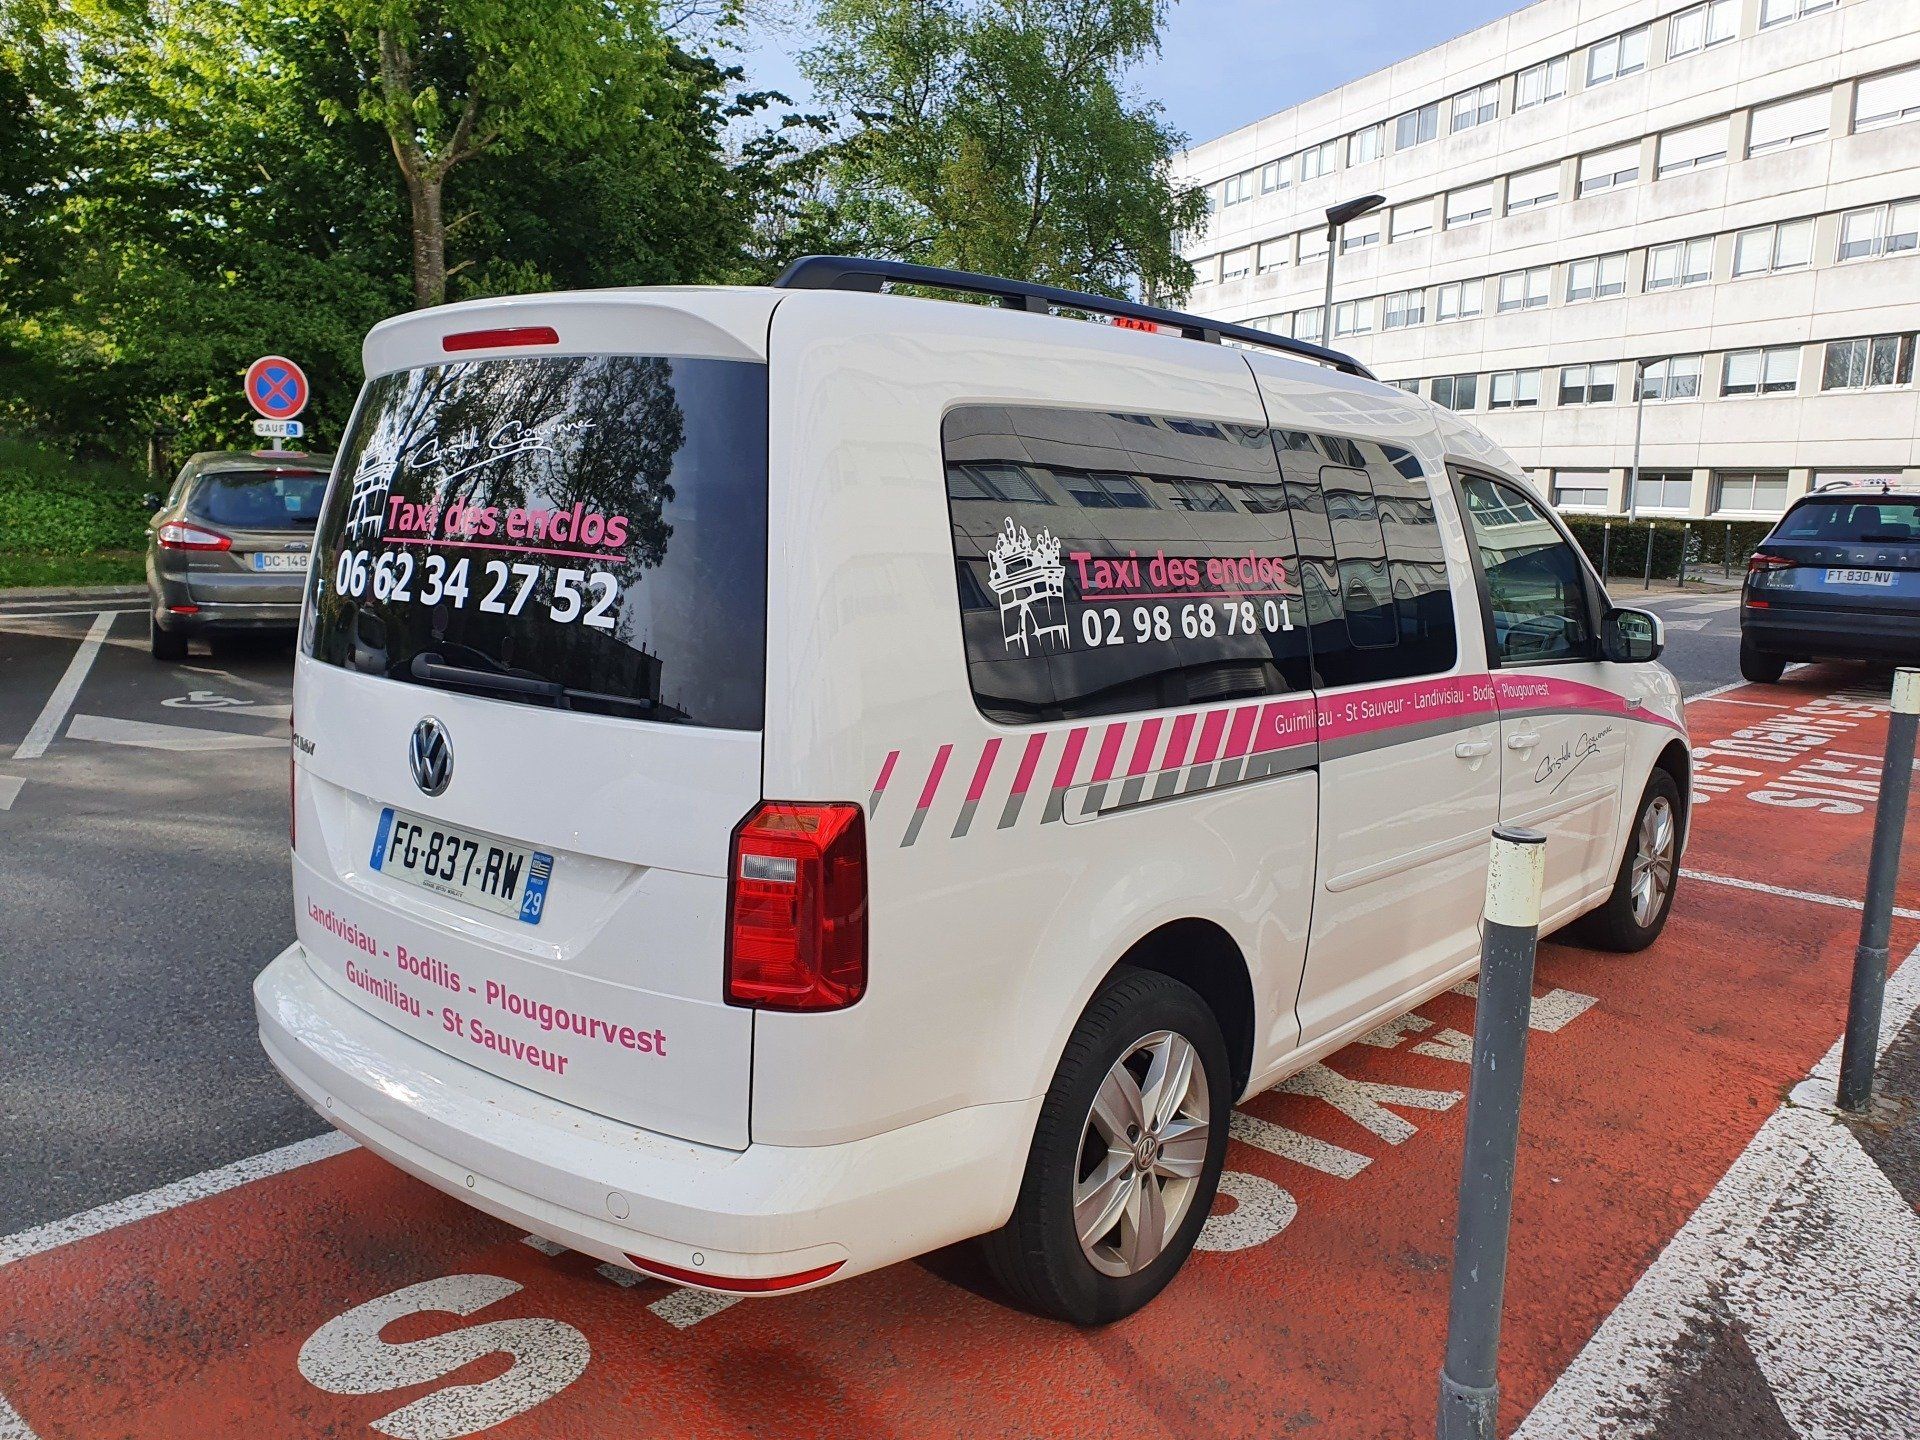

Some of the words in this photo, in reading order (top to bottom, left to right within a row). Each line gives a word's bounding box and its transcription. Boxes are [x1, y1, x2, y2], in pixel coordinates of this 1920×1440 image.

[258, 424, 284, 432] SAUF
[389, 494, 437, 531] Taxi
[445, 497, 498, 536] des
[506, 502, 628, 547] enclos
[335, 550, 369, 597] 06
[373, 552, 413, 601] 62
[420, 555, 469, 608] 34
[479, 561, 540, 616] 27
[549, 568, 618, 629] 52
[1070, 550, 1140, 589] Taxi
[1149, 550, 1200, 587] des
[1206, 550, 1286, 585] enclos
[1827, 571, 1891, 583] FT-830-NV
[1081, 608, 1124, 647] 02
[1132, 605, 1172, 643] 98
[1181, 603, 1216, 639] 68
[1223, 601, 1257, 635] 78
[1263, 600, 1294, 633] 01
[1345, 703, 1358, 722] St
[1361, 698, 1404, 719] Sauveur
[1414, 688, 1464, 709] Landivisiau
[1501, 682, 1550, 700] Plougourvest
[389, 820, 524, 901] FG-837-RW
[522, 890, 542, 915] 29
[308, 895, 377, 957] Landivisiau
[397, 945, 461, 992] Bodilis
[486, 980, 667, 1057] Plougourvest
[346, 960, 420, 1018] Guimiliau
[442, 1007, 464, 1037] St
[470, 1018, 568, 1075] Sauveur
